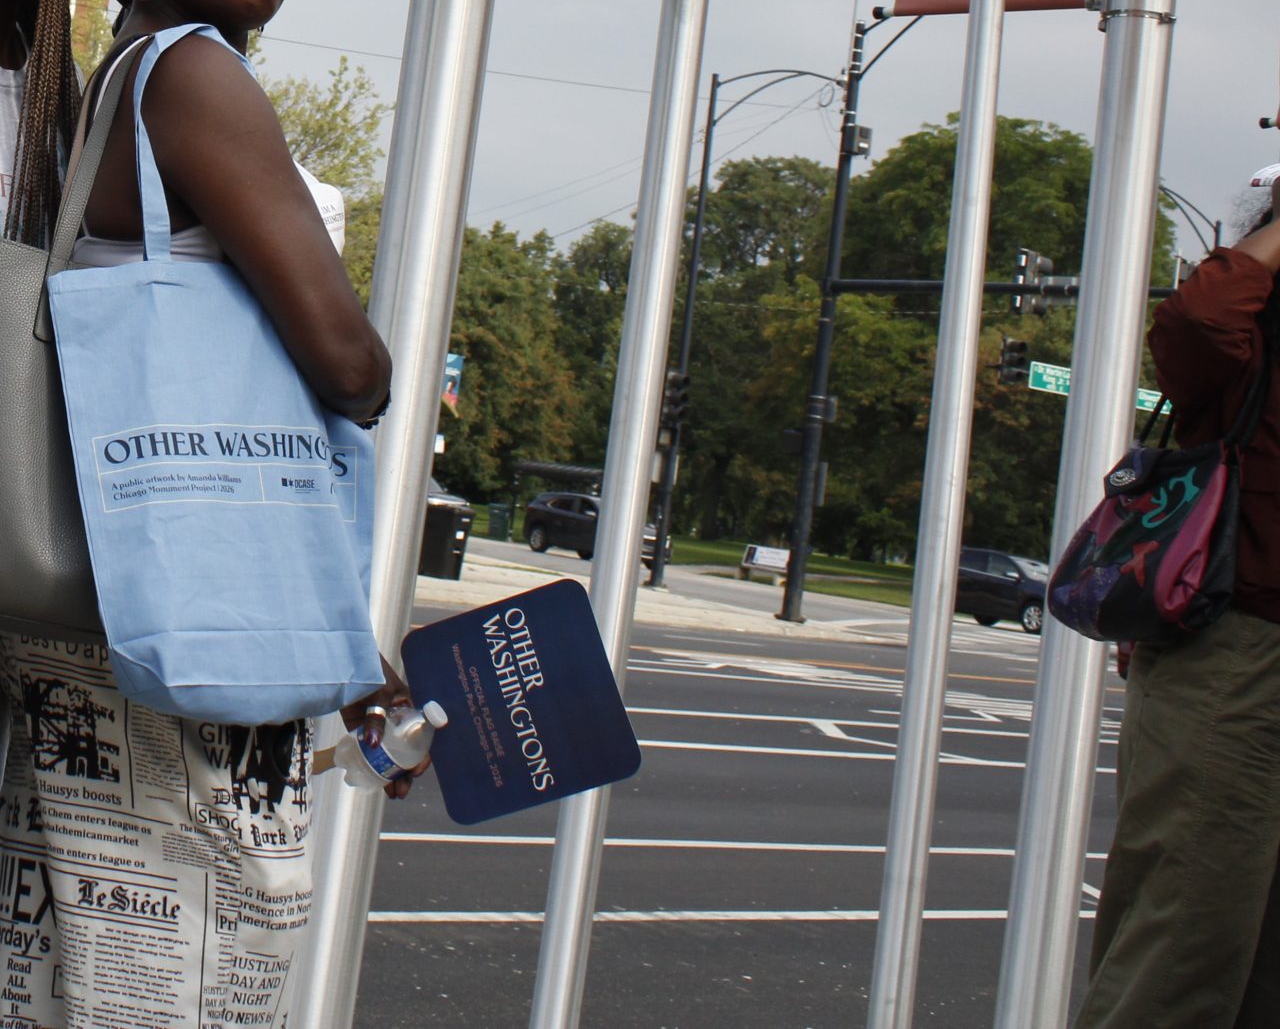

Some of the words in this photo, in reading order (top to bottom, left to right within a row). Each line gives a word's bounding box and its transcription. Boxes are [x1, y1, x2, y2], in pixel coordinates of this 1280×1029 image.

[104, 431, 209, 464] OTHER
[111, 482, 118, 491] A
[119, 478, 143, 491] public
[145, 473, 175, 484] artwork
[176, 473, 186, 483] by
[187, 473, 217, 482] Amanda
[113, 488, 147, 501] Chicago
[148, 483, 190, 494] Monument
[191, 483, 217, 493] Project
[505, 607, 544, 692] OTHER
[482, 613, 555, 792] WASHINGTONS
[39, 780, 79, 799] Hausys
[82, 786, 122, 806] boosts
[48, 807, 72, 820] Chem
[74, 813, 107, 826] enters
[108, 817, 140, 832] league
[141, 826, 152, 835] os
[66, 846, 97, 861] enters
[99, 852, 132, 867] league
[134, 859, 146, 869] os
[256, 889, 293, 906] Hausys
[287, 905, 295, 916] in
[237, 911, 288, 931] American
[289, 916, 308, 930] mark
[7, 958, 32, 974] Read
[229, 972, 256, 989] DAY
[257, 976, 281, 990] AND
[0, 987, 32, 1005] About
[232, 991, 271, 1006] NIGHT
[10, 1002, 20, 1015] It
[235, 1011, 267, 1025] NEWS
